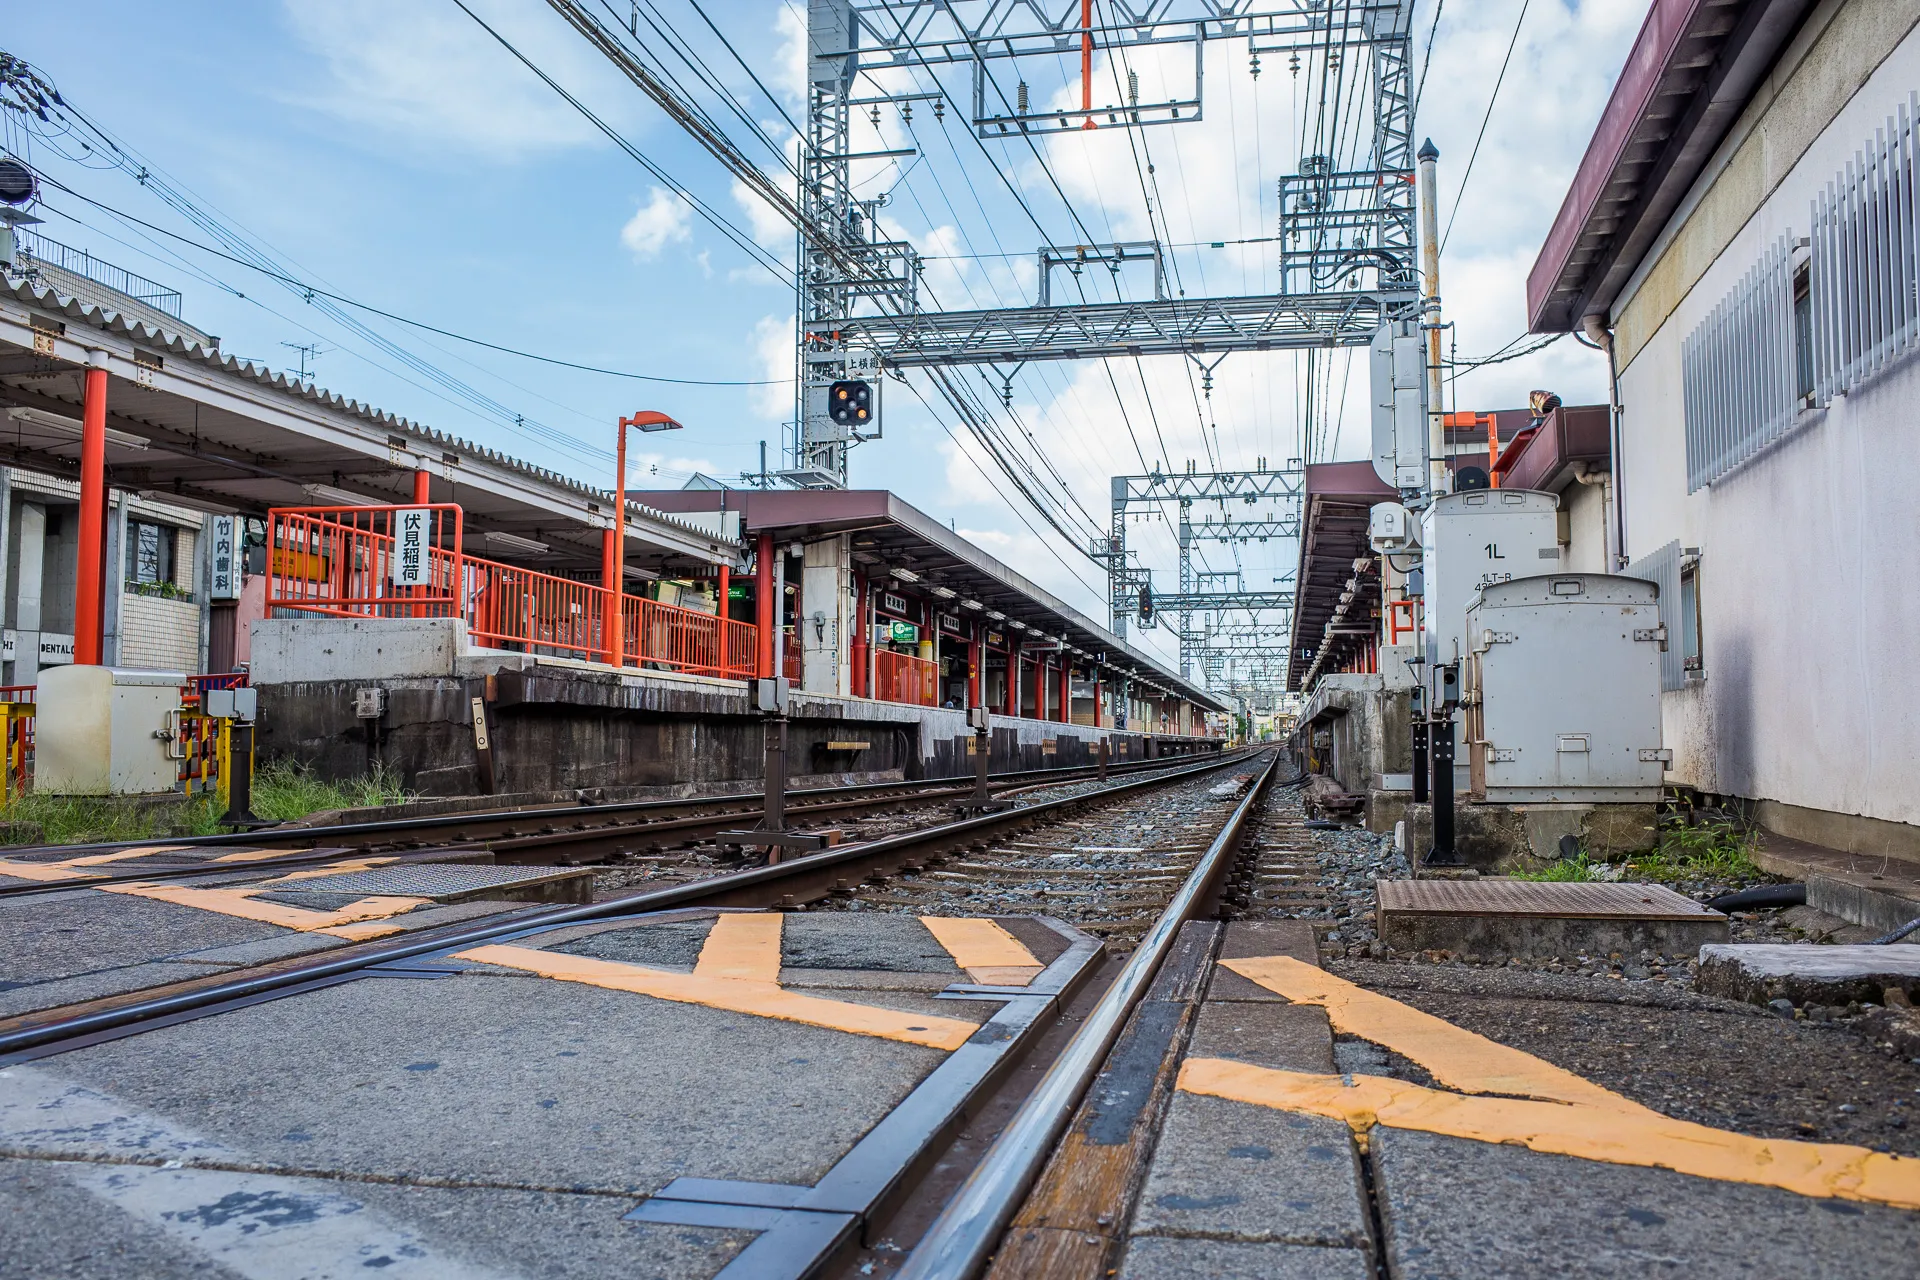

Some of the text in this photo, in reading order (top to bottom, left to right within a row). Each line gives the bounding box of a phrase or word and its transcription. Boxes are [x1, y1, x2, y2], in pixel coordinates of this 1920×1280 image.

[215, 520, 231, 591] 竹内歯科
[402, 513, 421, 581] 伏見稲荷
[1484, 543, 1506, 559] 1L
